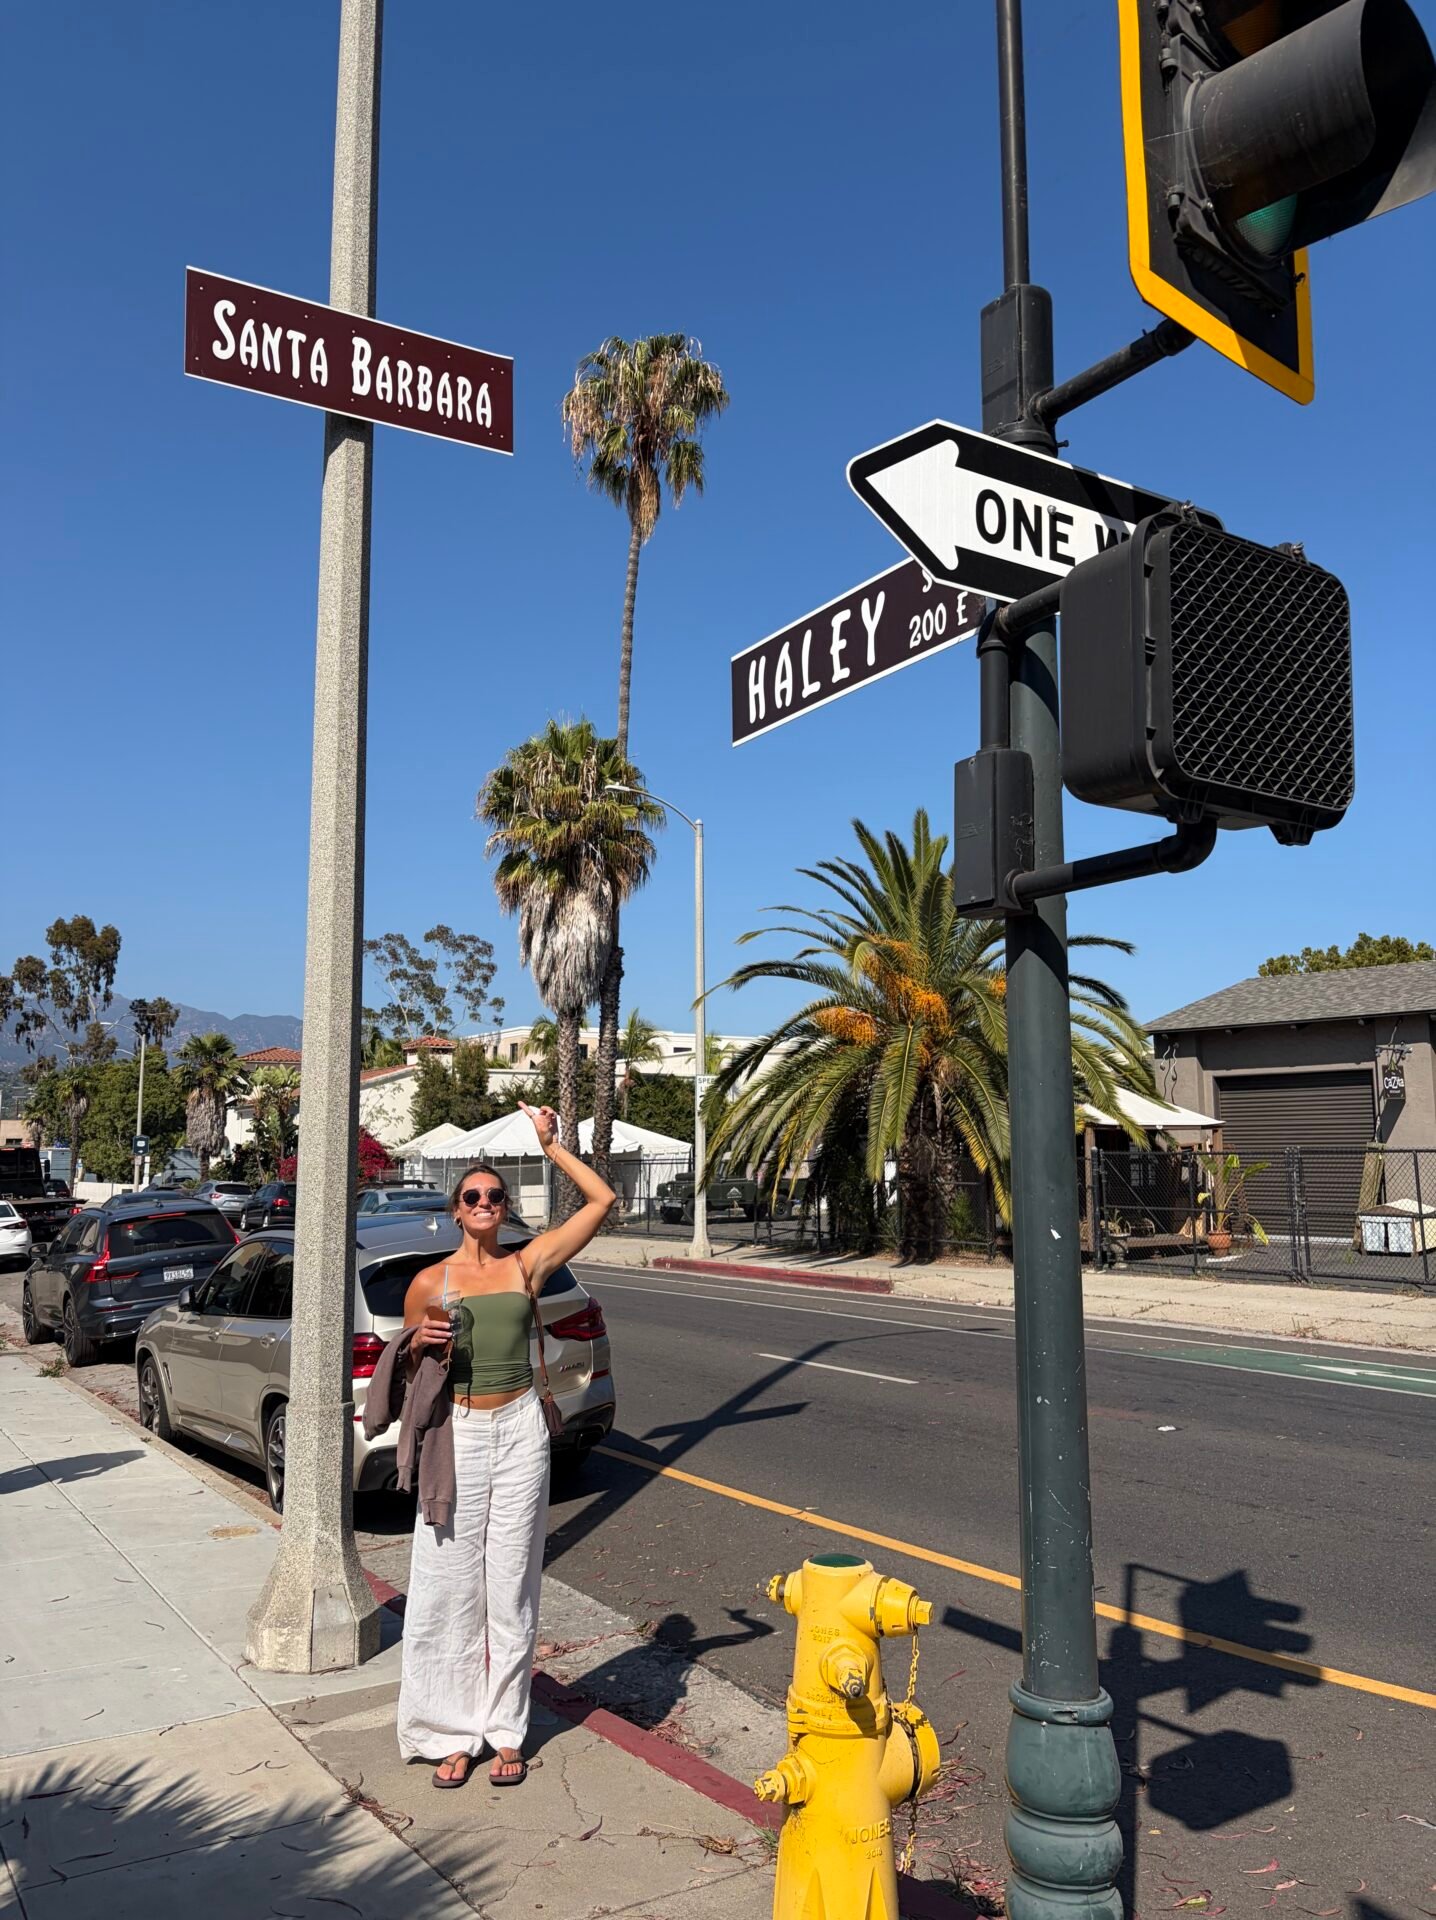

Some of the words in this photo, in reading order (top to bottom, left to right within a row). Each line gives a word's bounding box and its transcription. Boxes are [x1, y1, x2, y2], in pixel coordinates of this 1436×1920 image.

[212, 300, 328, 387] SANTA
[351, 336, 492, 428] BARBARA
[976, 489, 1076, 567] ONE
[909, 602, 947, 649] 200
[956, 591, 969, 626] E
[749, 591, 885, 724] HALEY
[810, 1625, 840, 1637] JONES
[851, 1817, 891, 1844] JONES
